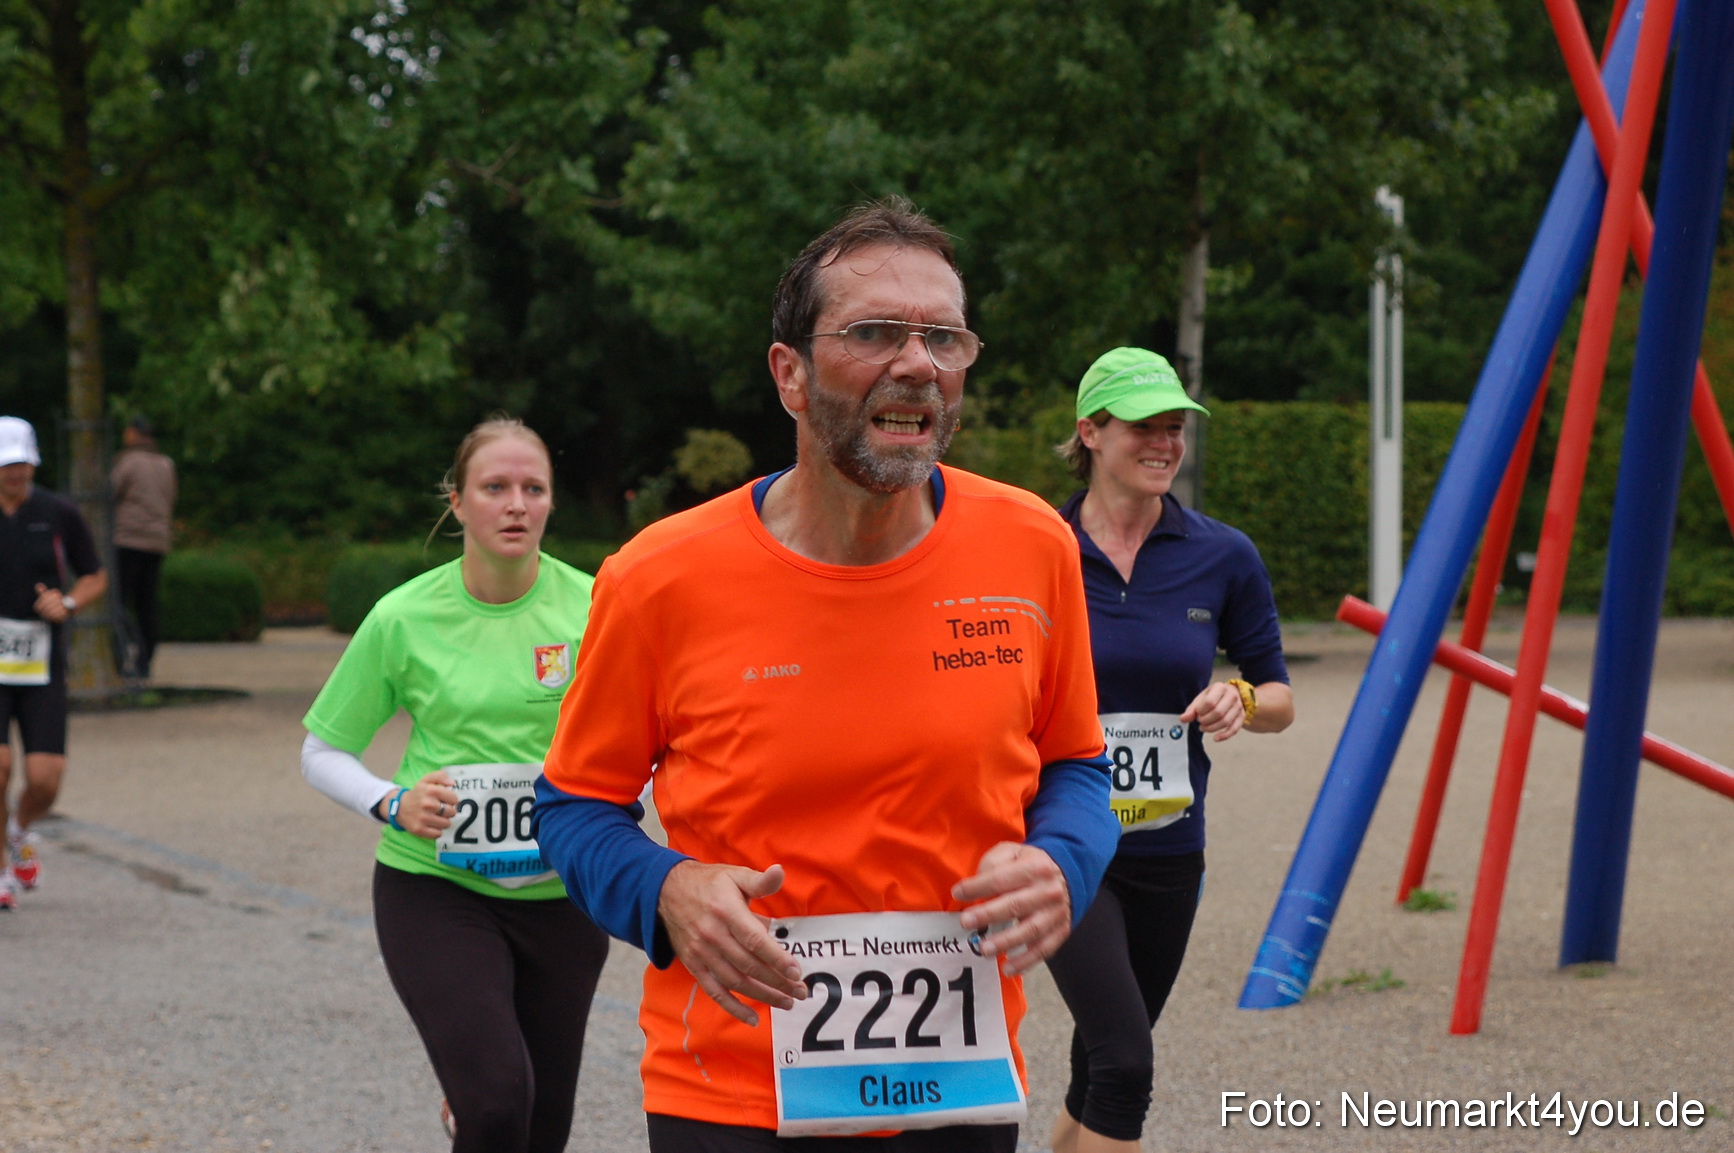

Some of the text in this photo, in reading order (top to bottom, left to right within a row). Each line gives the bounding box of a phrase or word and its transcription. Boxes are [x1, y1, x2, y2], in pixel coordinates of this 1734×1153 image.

[946, 617, 1011, 640] Team
[932, 645, 1024, 672] heba-tec
[762, 664, 801, 679] JAKO
[1104, 726, 1165, 739] Neumarkt
[492, 778, 535, 790] Neum
[465, 855, 549, 875] Katharin
[862, 936, 963, 957] Neumarkt
[801, 966, 978, 1053] 2221
[784, 1050, 794, 1064] C
[859, 1075, 942, 1107] Claus
